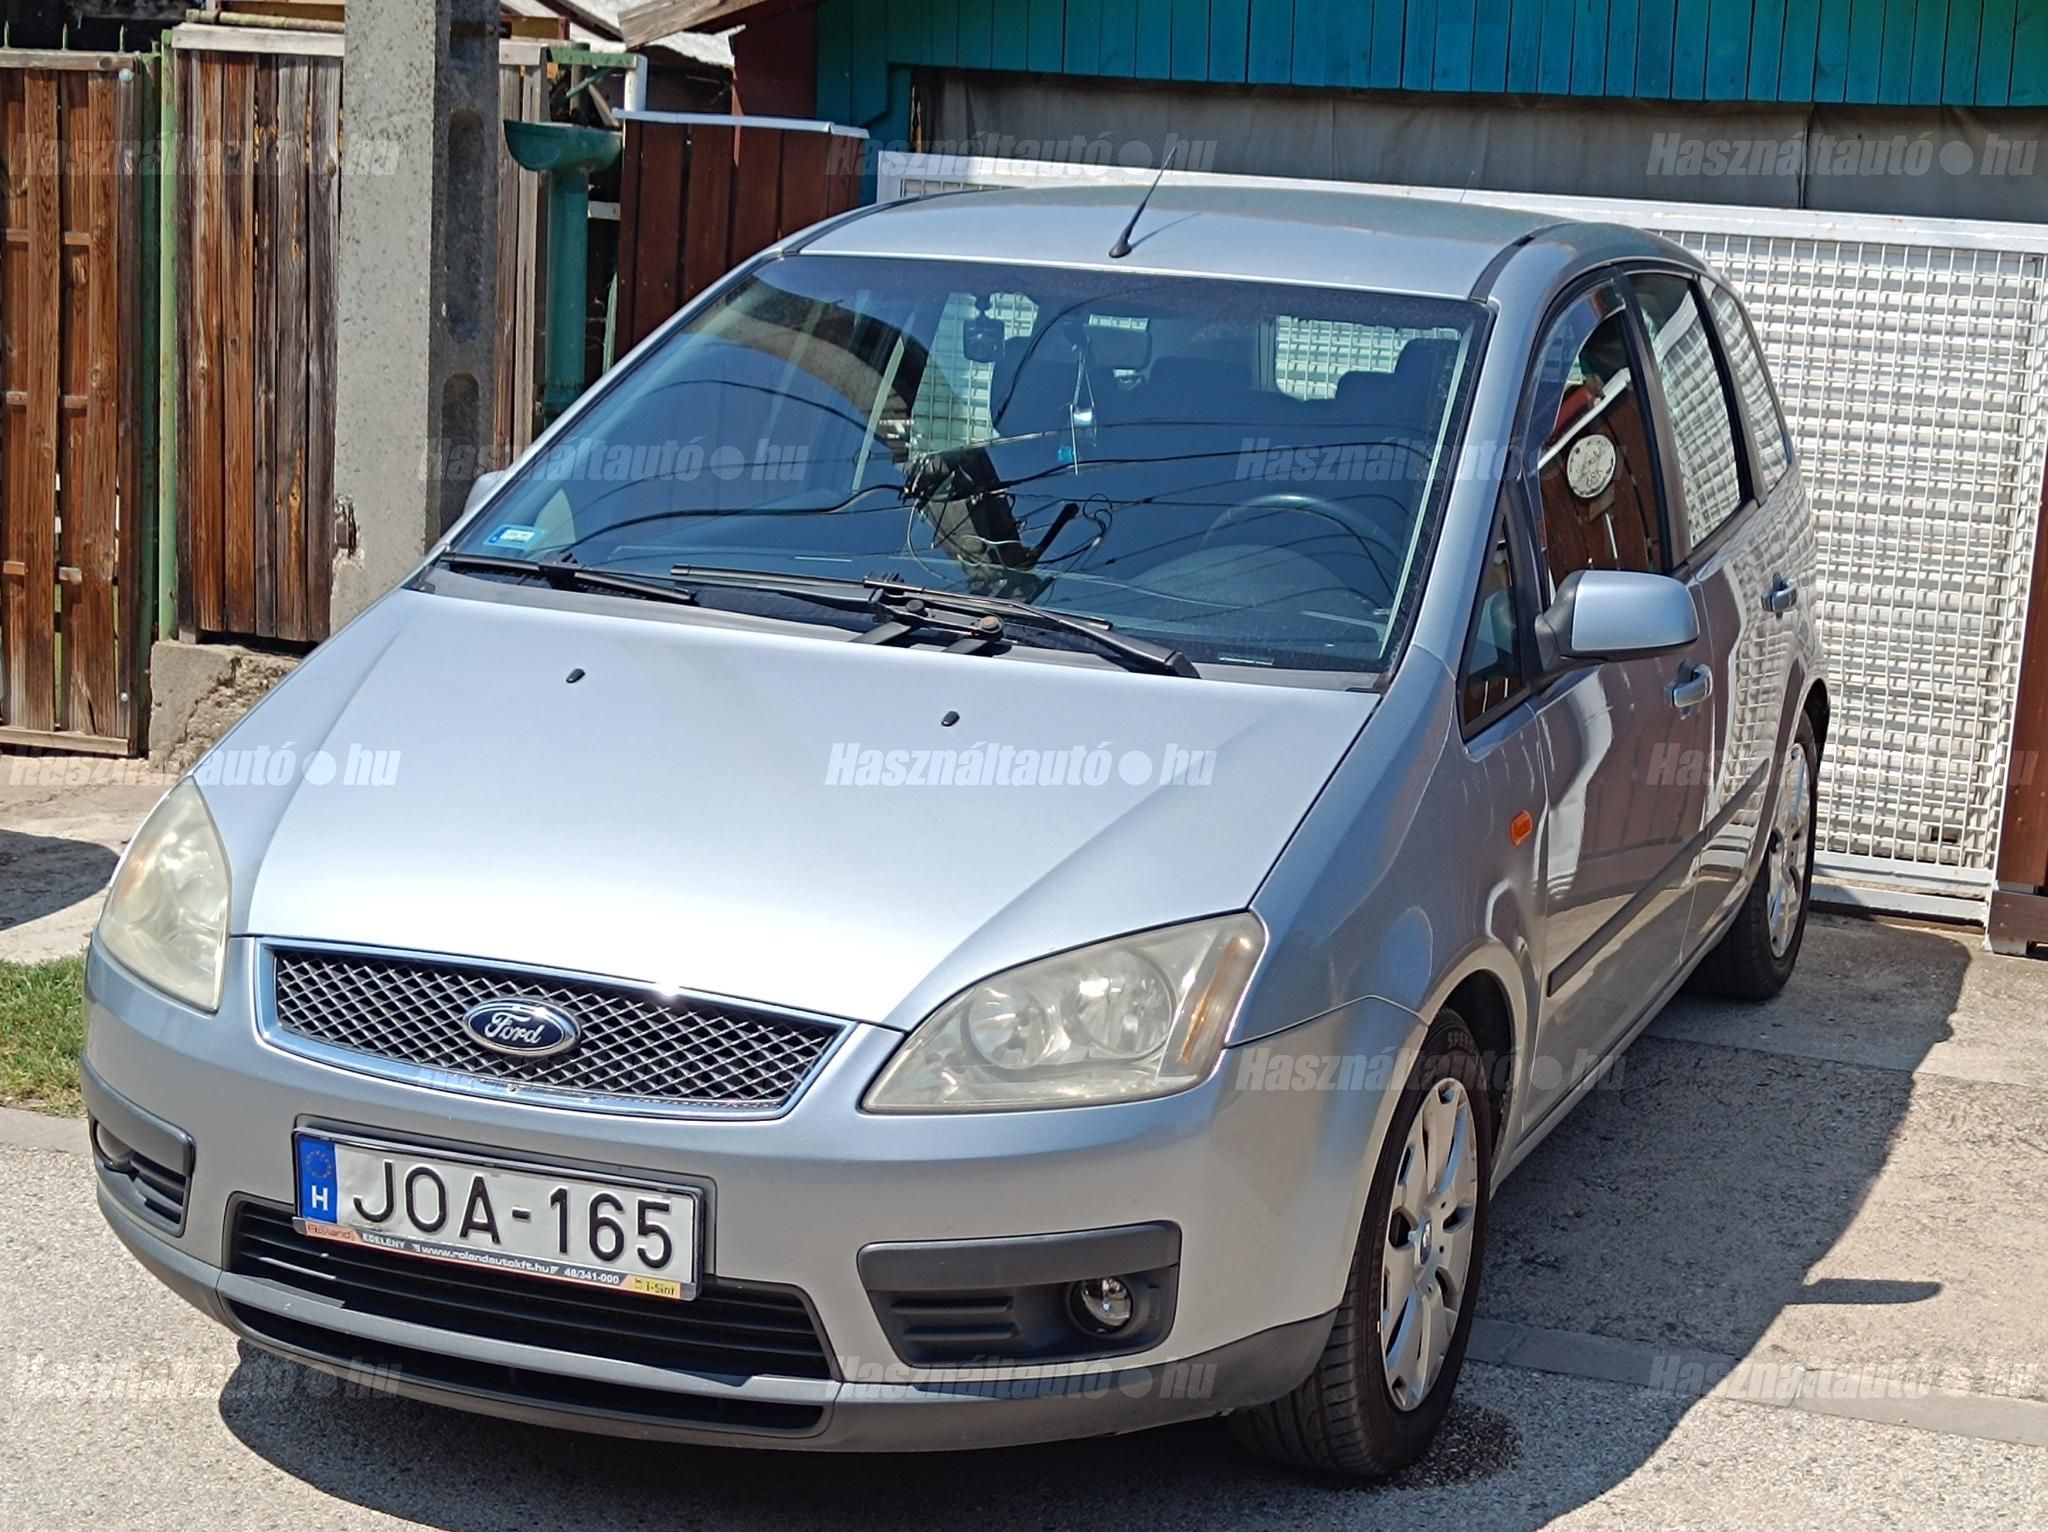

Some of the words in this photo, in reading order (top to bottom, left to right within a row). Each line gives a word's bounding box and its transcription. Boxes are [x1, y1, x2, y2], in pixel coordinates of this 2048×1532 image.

[484, 1012, 545, 1044] Ford
[311, 1185, 329, 1212] H
[352, 1160, 673, 1269] JOA-165
